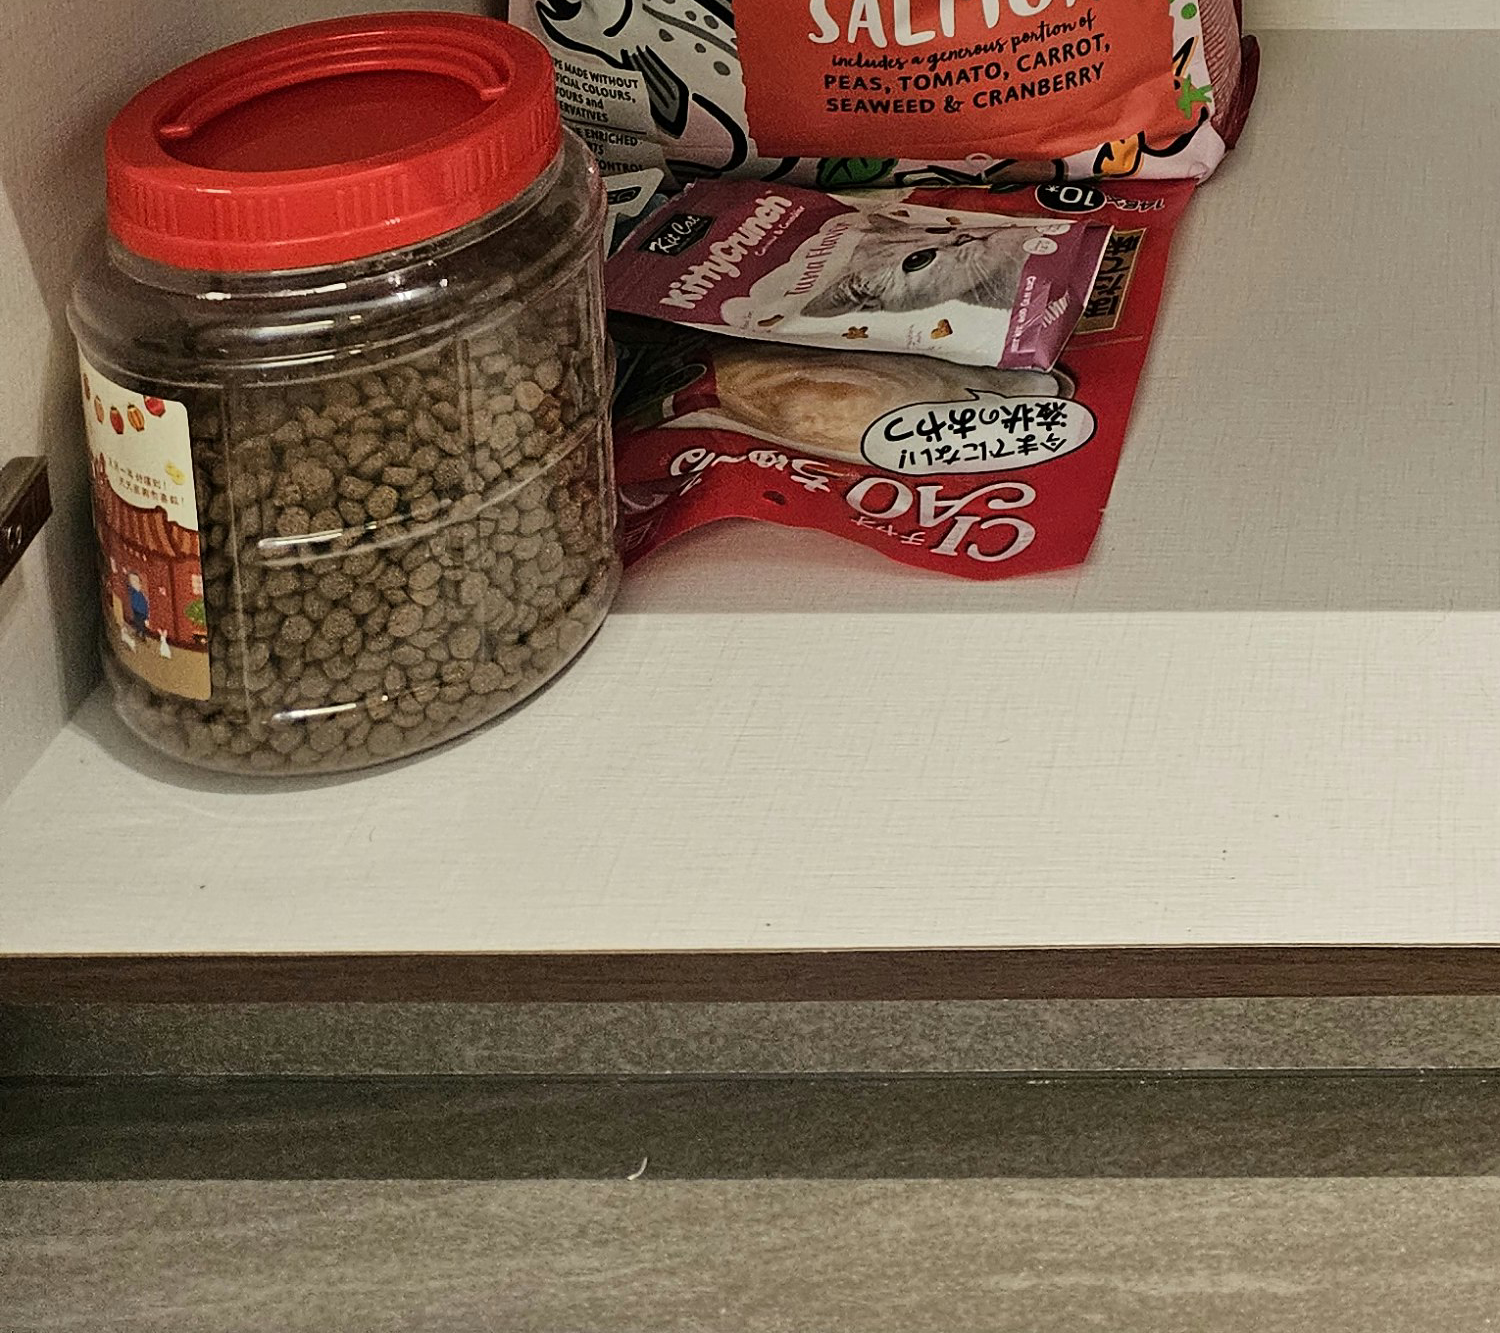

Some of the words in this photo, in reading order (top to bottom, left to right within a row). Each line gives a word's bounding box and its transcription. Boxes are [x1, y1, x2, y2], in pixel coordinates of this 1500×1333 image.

[832, 51, 907, 71] includes
[911, 53, 925, 66] a
[926, 36, 1010, 72] generous
[1010, 20, 1078, 54] portion
[1078, 8, 1098, 33] of
[564, 62, 589, 81] MADE
[588, 70, 639, 90] WITHOUT
[823, 73, 892, 95] PEAS,
[897, 62, 1011, 92] TOMATO,
[1016, 33, 1111, 74] CARROT,
[556, 72, 579, 91] FICIAL
[581, 82, 637, 104] COLOURS,
[585, 97, 604, 110] and
[825, 95, 936, 115] SEAWEED
[943, 94, 966, 114] &
[972, 61, 1106, 110] CRANBERRY
[560, 100, 609, 123] ERVATIVES
[585, 127, 639, 147] ENRICHED
[883, 400, 1069, 443] 液状のおやつ
[850, 515, 927, 547] チャオ
